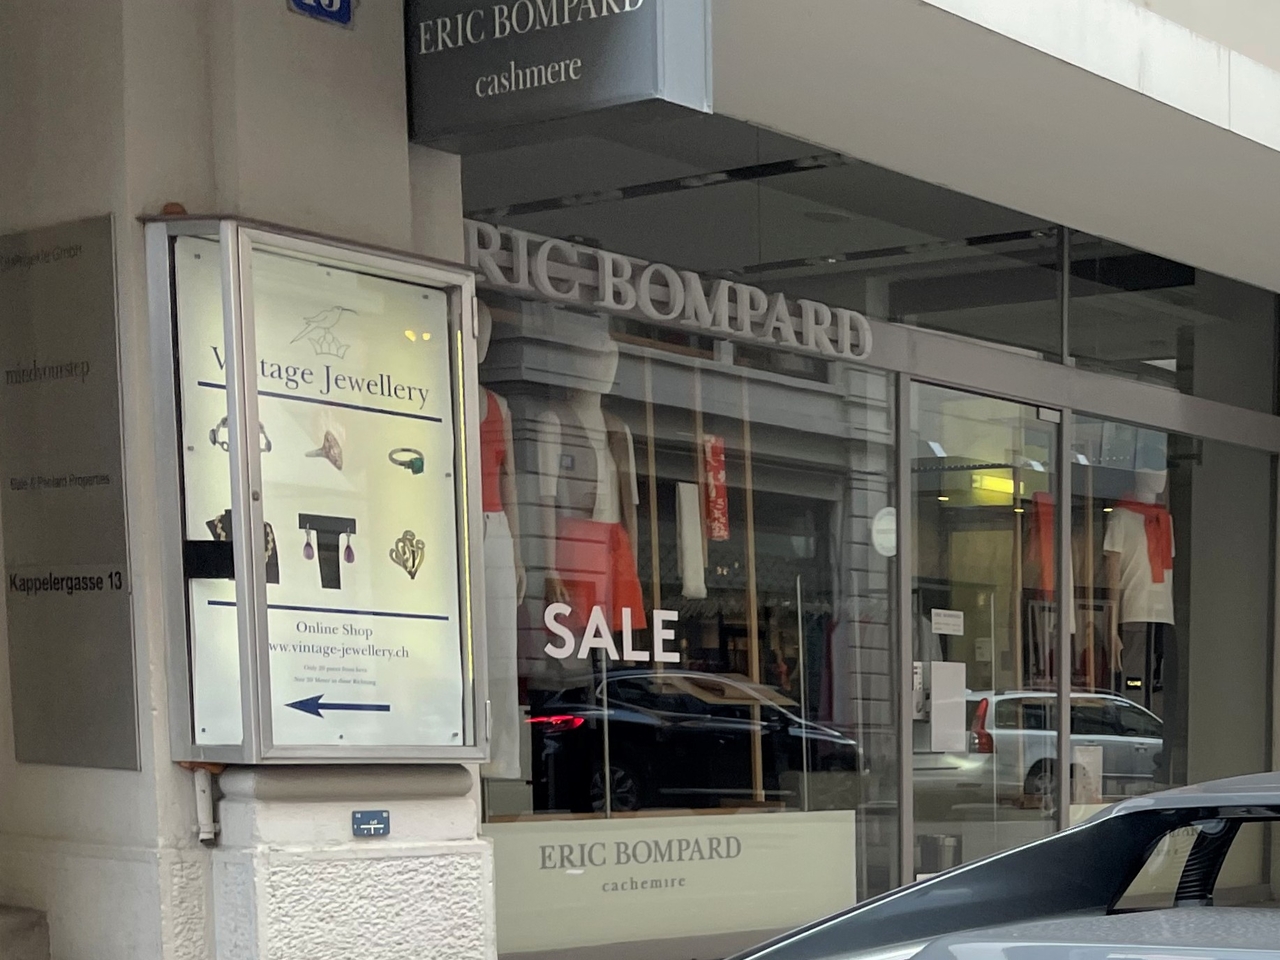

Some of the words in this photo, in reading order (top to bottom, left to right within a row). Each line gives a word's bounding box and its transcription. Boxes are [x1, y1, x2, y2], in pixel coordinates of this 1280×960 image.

[419, 9, 485, 55] ERIC
[475, 58, 582, 97] cashmere
[463, 217, 579, 299] RIC
[596, 250, 873, 361] BOMPARD
[210, 345, 313, 390] Vtage
[320, 364, 429, 410] Jewellery
[9, 572, 104, 596] Kappelergasse
[108, 570, 122, 590] 13
[296, 620, 339, 635] Online
[342, 624, 373, 640] Shop
[543, 602, 681, 663] SALE
[269, 641, 409, 662] ww.vintage-jewellery.ch
[539, 842, 607, 870] ERIC
[614, 835, 742, 865] BOMPARD
[602, 877, 686, 892] cachemire
